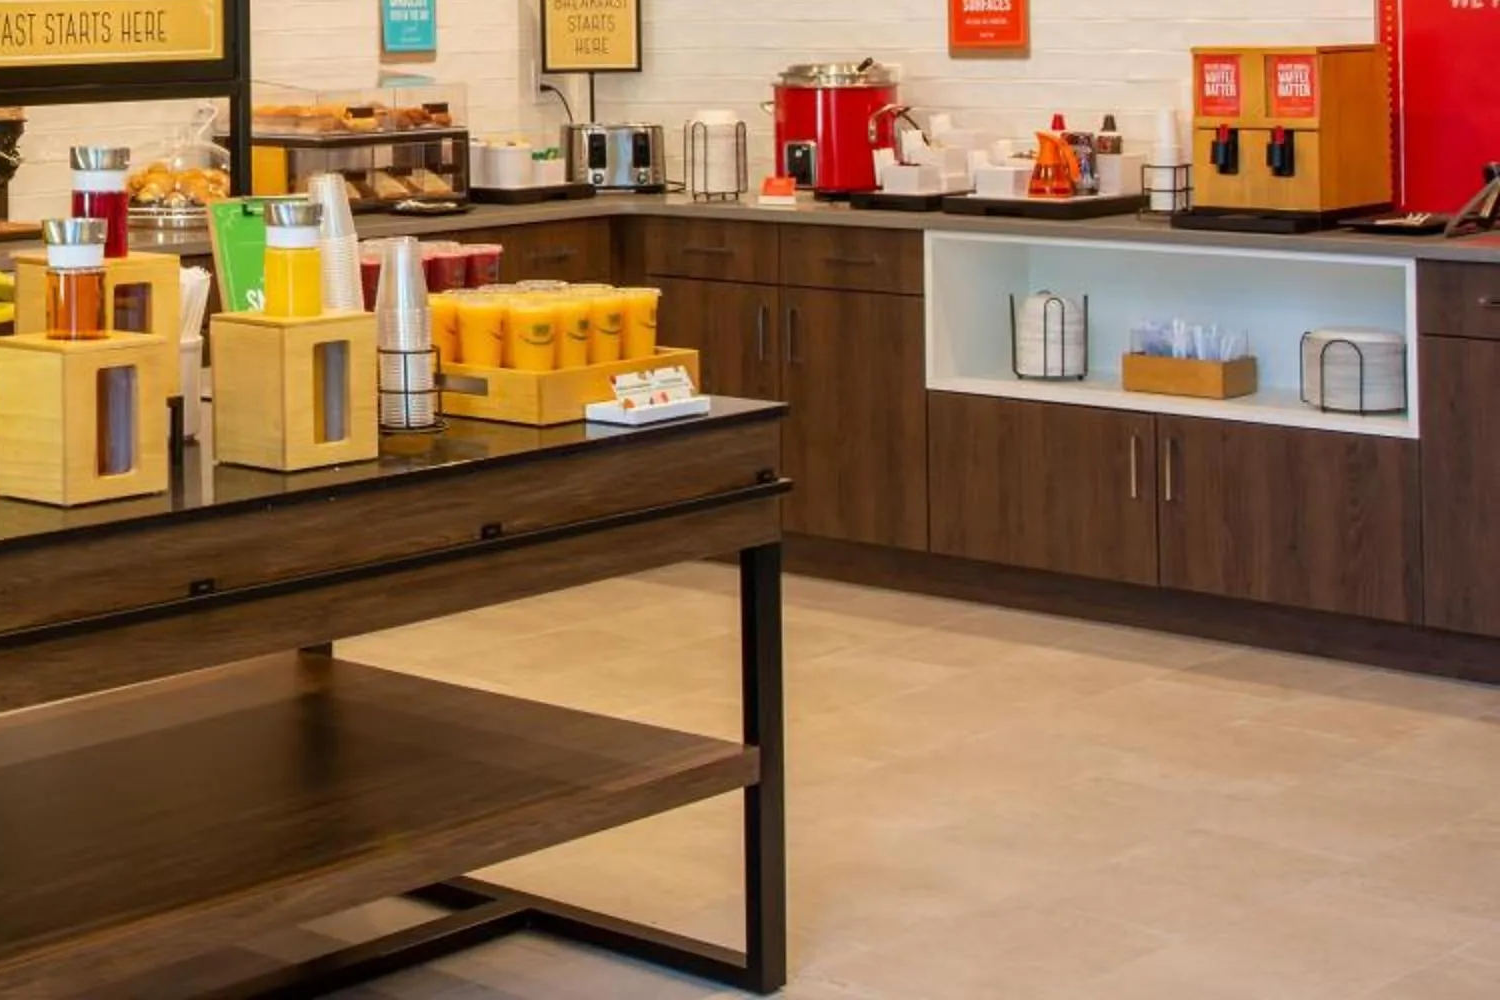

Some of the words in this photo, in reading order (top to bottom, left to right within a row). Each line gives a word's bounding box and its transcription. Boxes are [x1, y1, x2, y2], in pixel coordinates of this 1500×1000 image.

[44, 11, 112, 46] STARTS
[121, 9, 167, 43] HERE
[566, 14, 616, 33] STARTS
[575, 37, 610, 56] HERE
